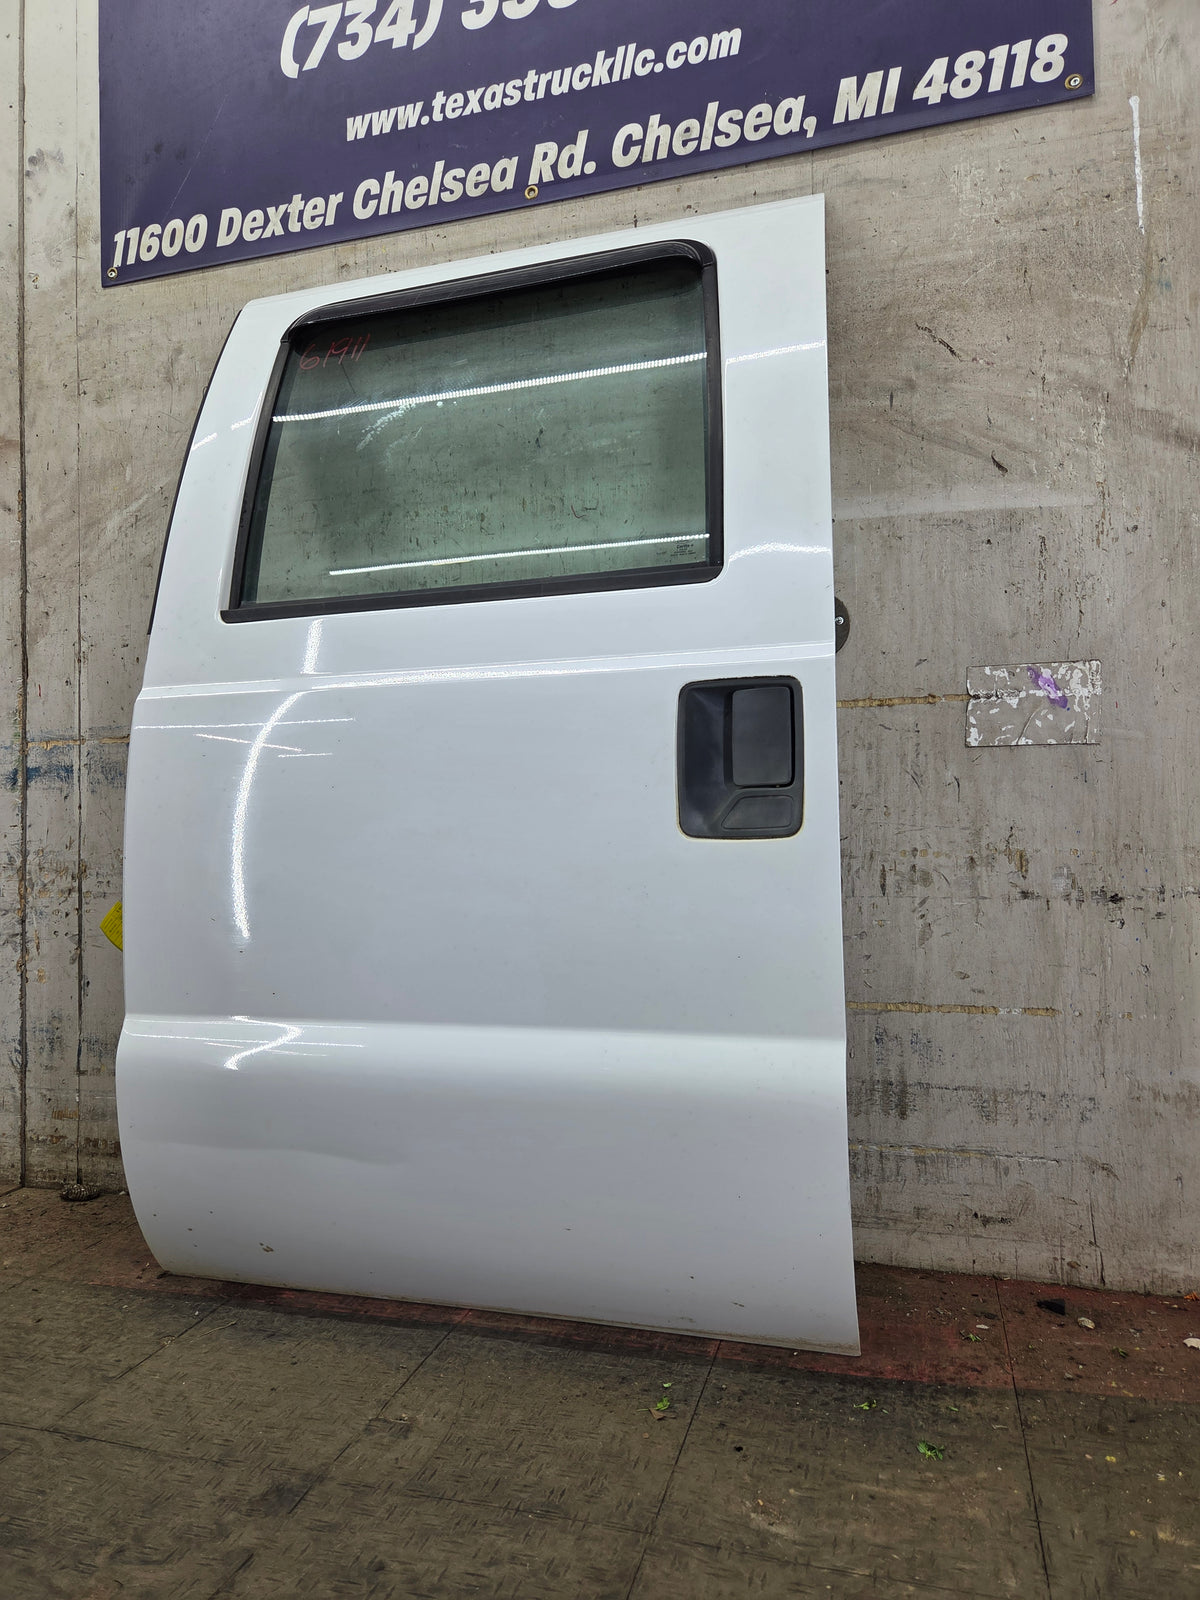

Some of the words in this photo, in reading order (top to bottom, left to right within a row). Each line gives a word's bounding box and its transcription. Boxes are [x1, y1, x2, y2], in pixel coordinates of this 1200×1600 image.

[280, 0, 443, 79] (734)
[347, 28, 742, 142] www.texastruckllc.com
[112, 214, 208, 269] 11600
[216, 186, 343, 248] Dexter
[352, 156, 519, 220] Chelsea
[528, 130, 597, 187] Rd.
[612, 95, 817, 168] Chelsea,
[833, 67, 903, 125] MI
[912, 34, 1069, 105] 48118
